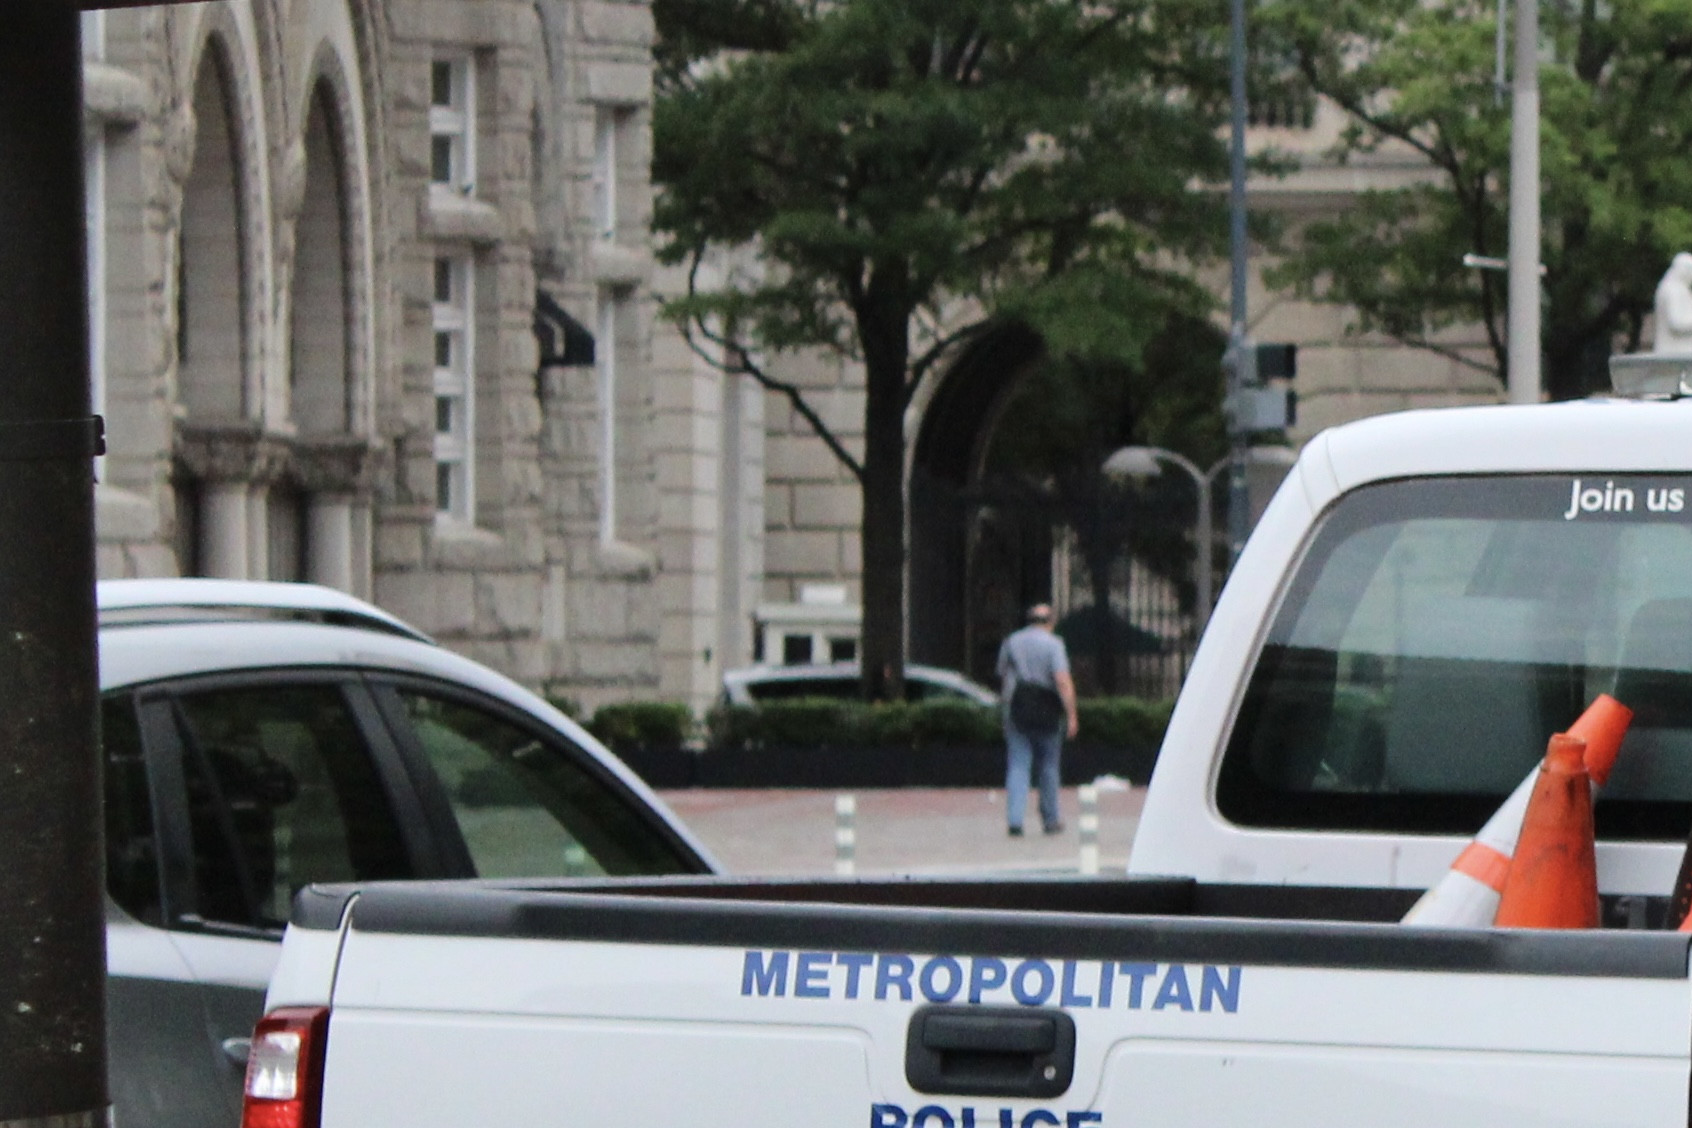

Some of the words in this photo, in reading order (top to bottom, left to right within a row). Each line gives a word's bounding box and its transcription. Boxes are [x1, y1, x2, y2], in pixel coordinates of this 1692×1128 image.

[1565, 480, 1634, 519] Join
[1646, 488, 1684, 512] us
[741, 950, 1242, 1014] METROPOLITAN
